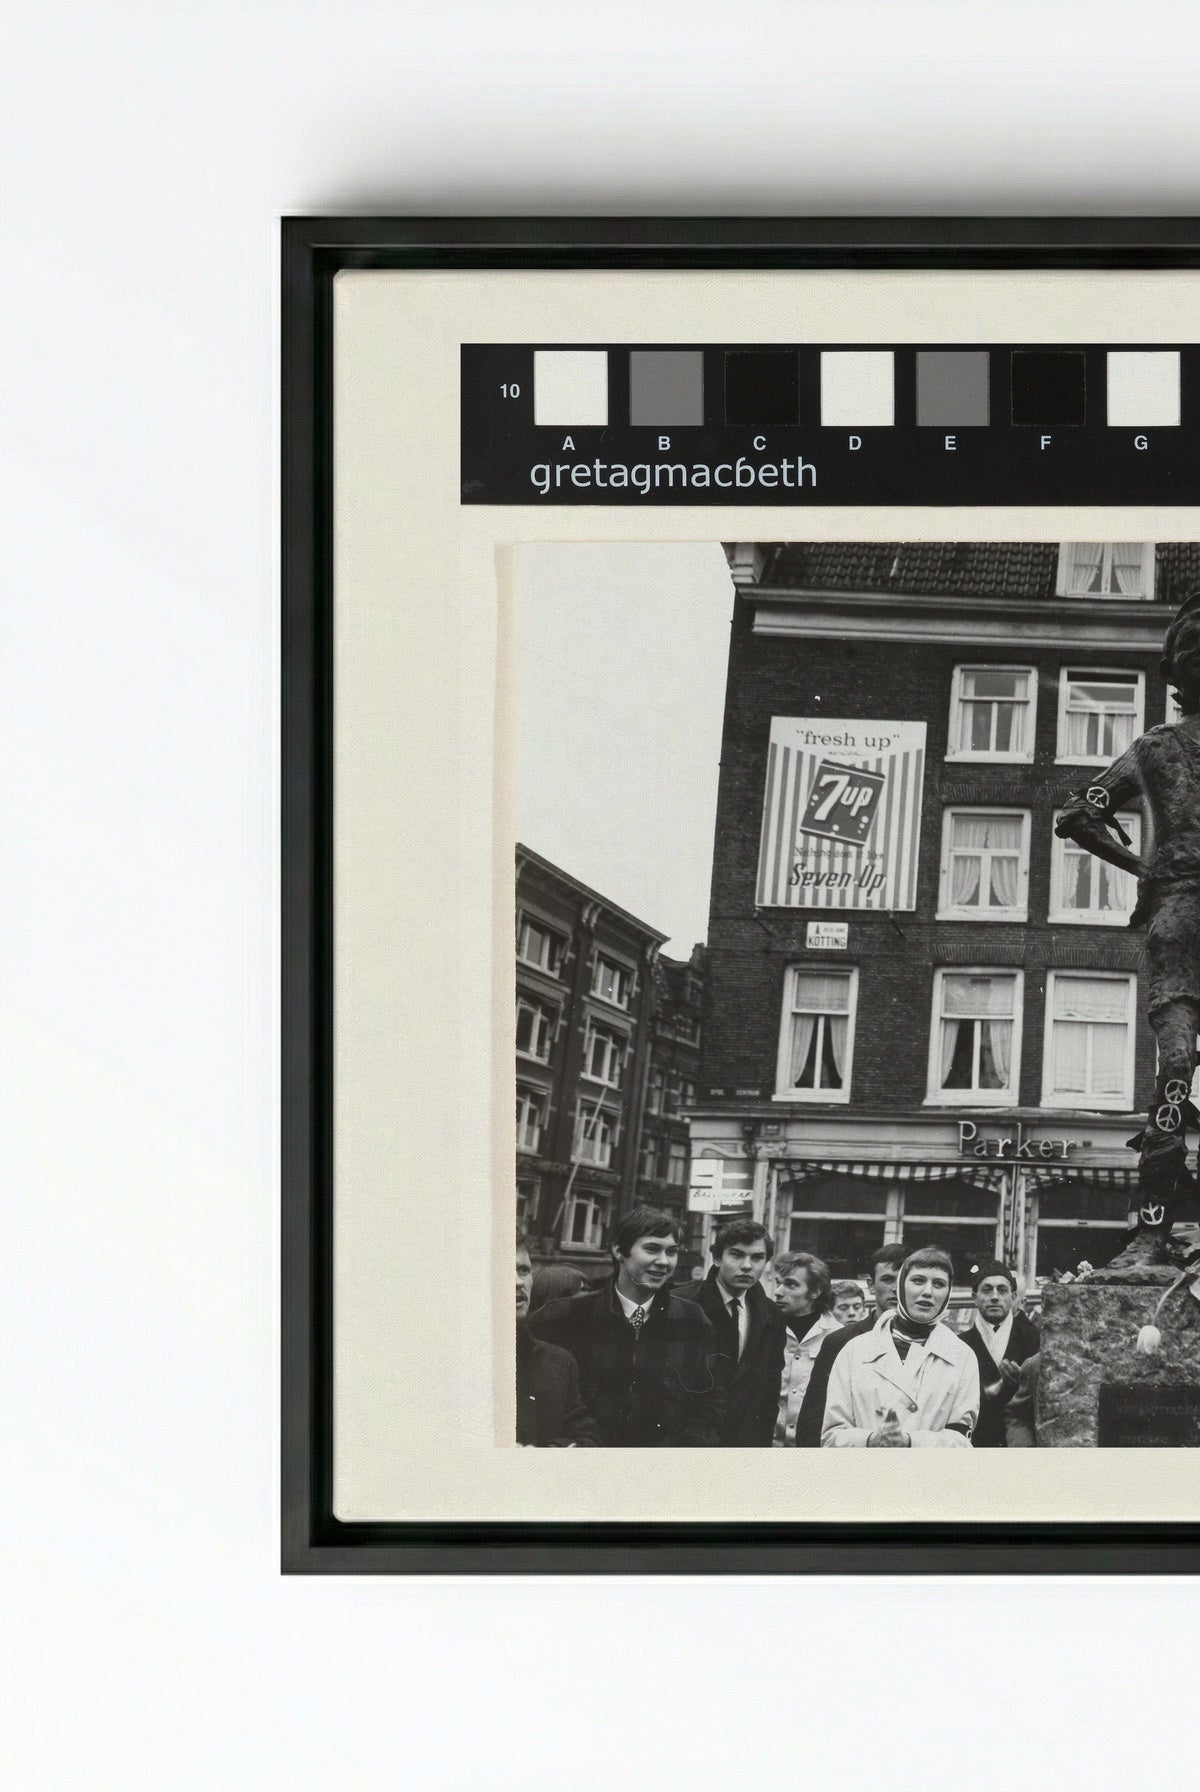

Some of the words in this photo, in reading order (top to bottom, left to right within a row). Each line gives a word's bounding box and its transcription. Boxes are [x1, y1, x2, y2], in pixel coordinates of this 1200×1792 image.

[499, 383, 521, 399] 10
[562, 435, 576, 451] A
[658, 435, 671, 451] B
[753, 435, 767, 451] C
[848, 435, 862, 451] D
[944, 435, 957, 451] E
[1040, 435, 1052, 451] F
[1134, 435, 1148, 451] G
[530, 456, 817, 495] gretagmacbeth
[957, 1120, 1077, 1159] Parker
